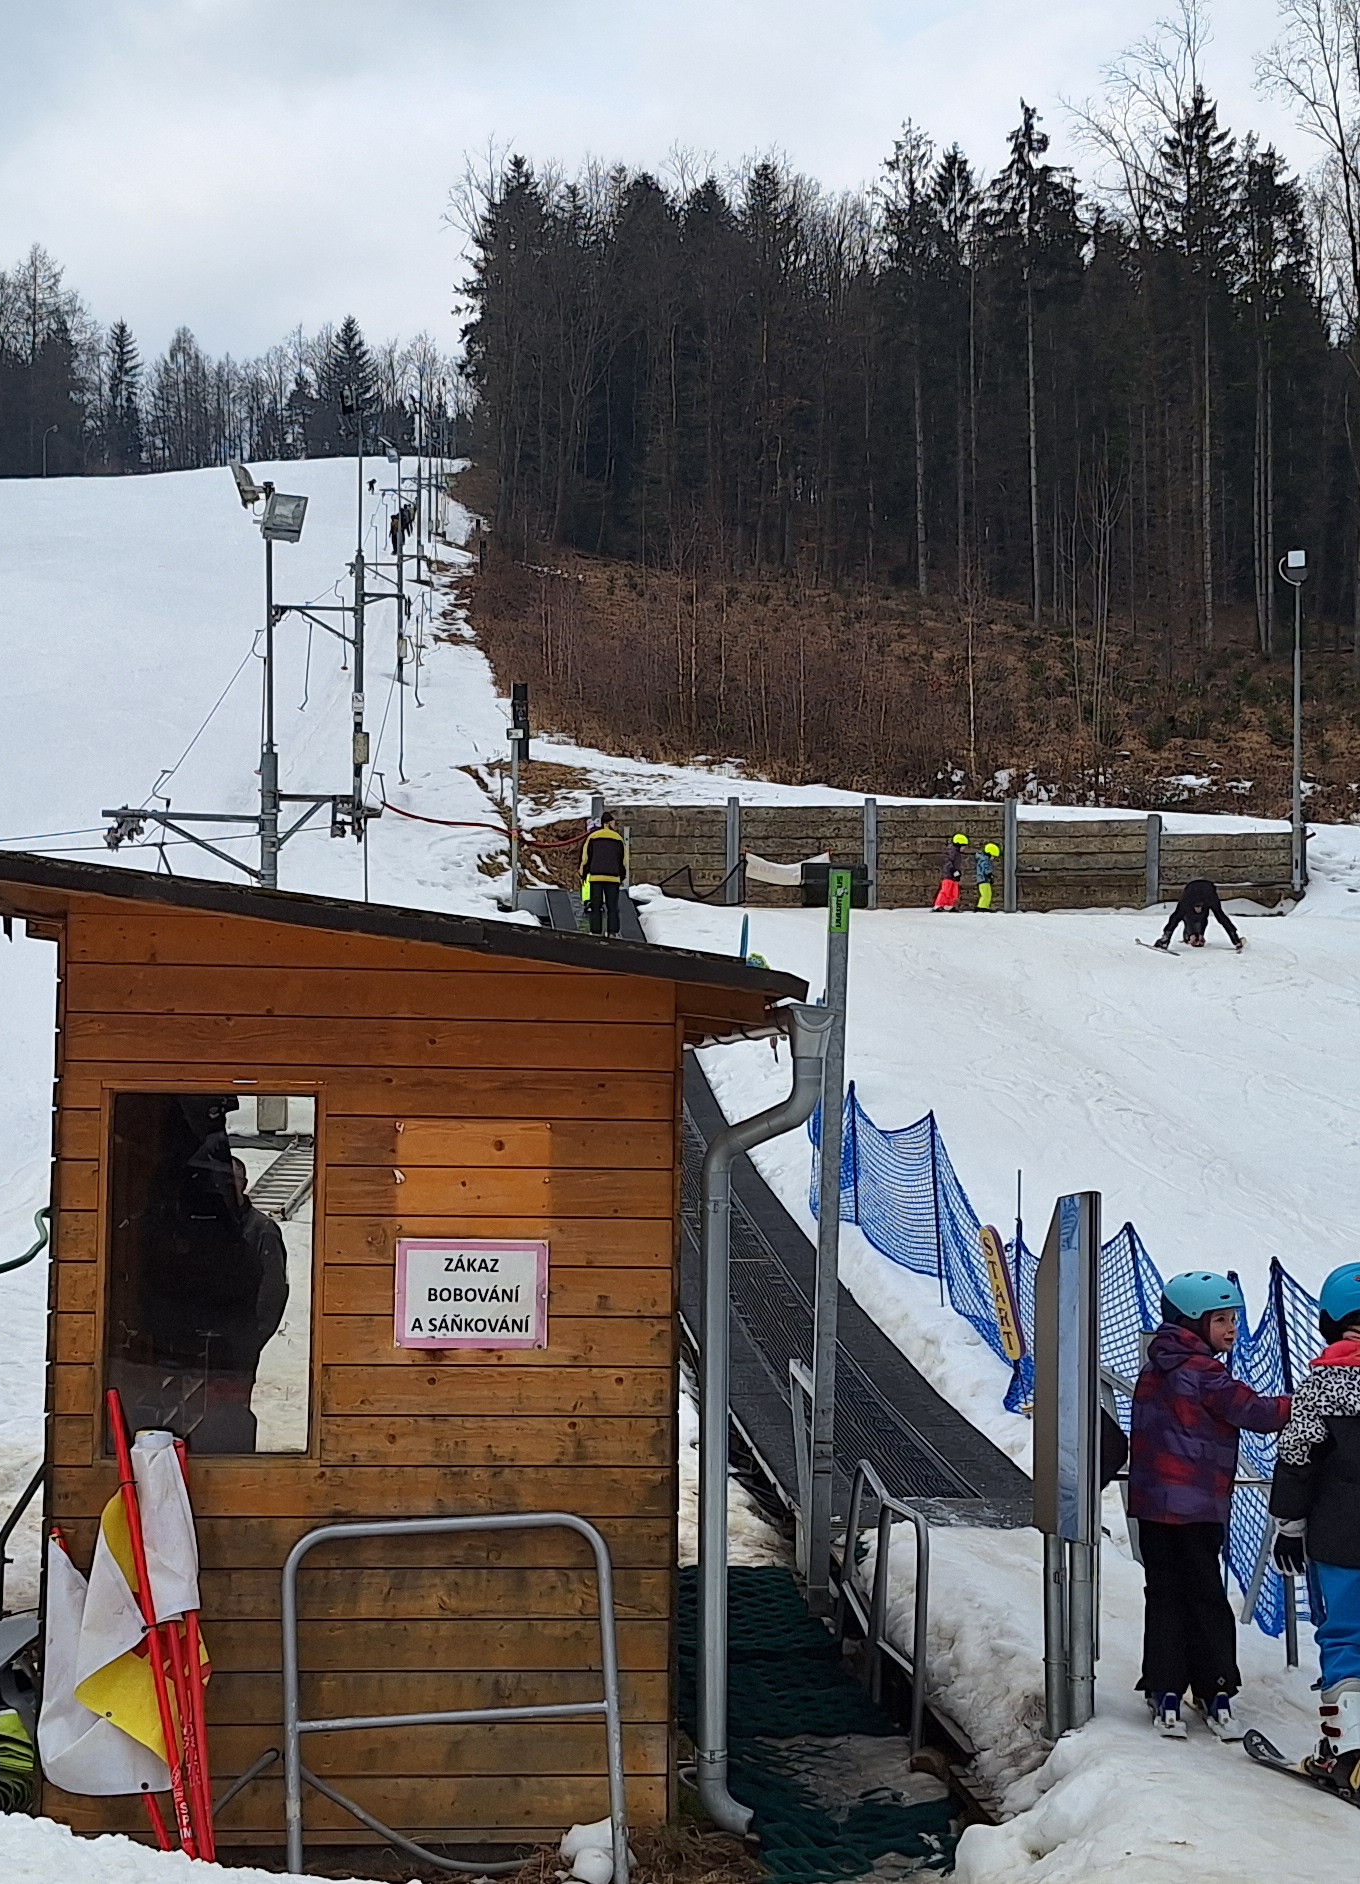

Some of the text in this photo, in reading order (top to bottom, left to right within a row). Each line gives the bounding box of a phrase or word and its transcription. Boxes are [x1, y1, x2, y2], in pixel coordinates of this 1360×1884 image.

[443, 1254, 500, 1273] ZÁKAZ
[427, 1285, 521, 1303] BOBOVÁNÍ
[982, 1236, 1014, 1351] START
[410, 1314, 531, 1333] A SÁŇKOVÁNÍ
